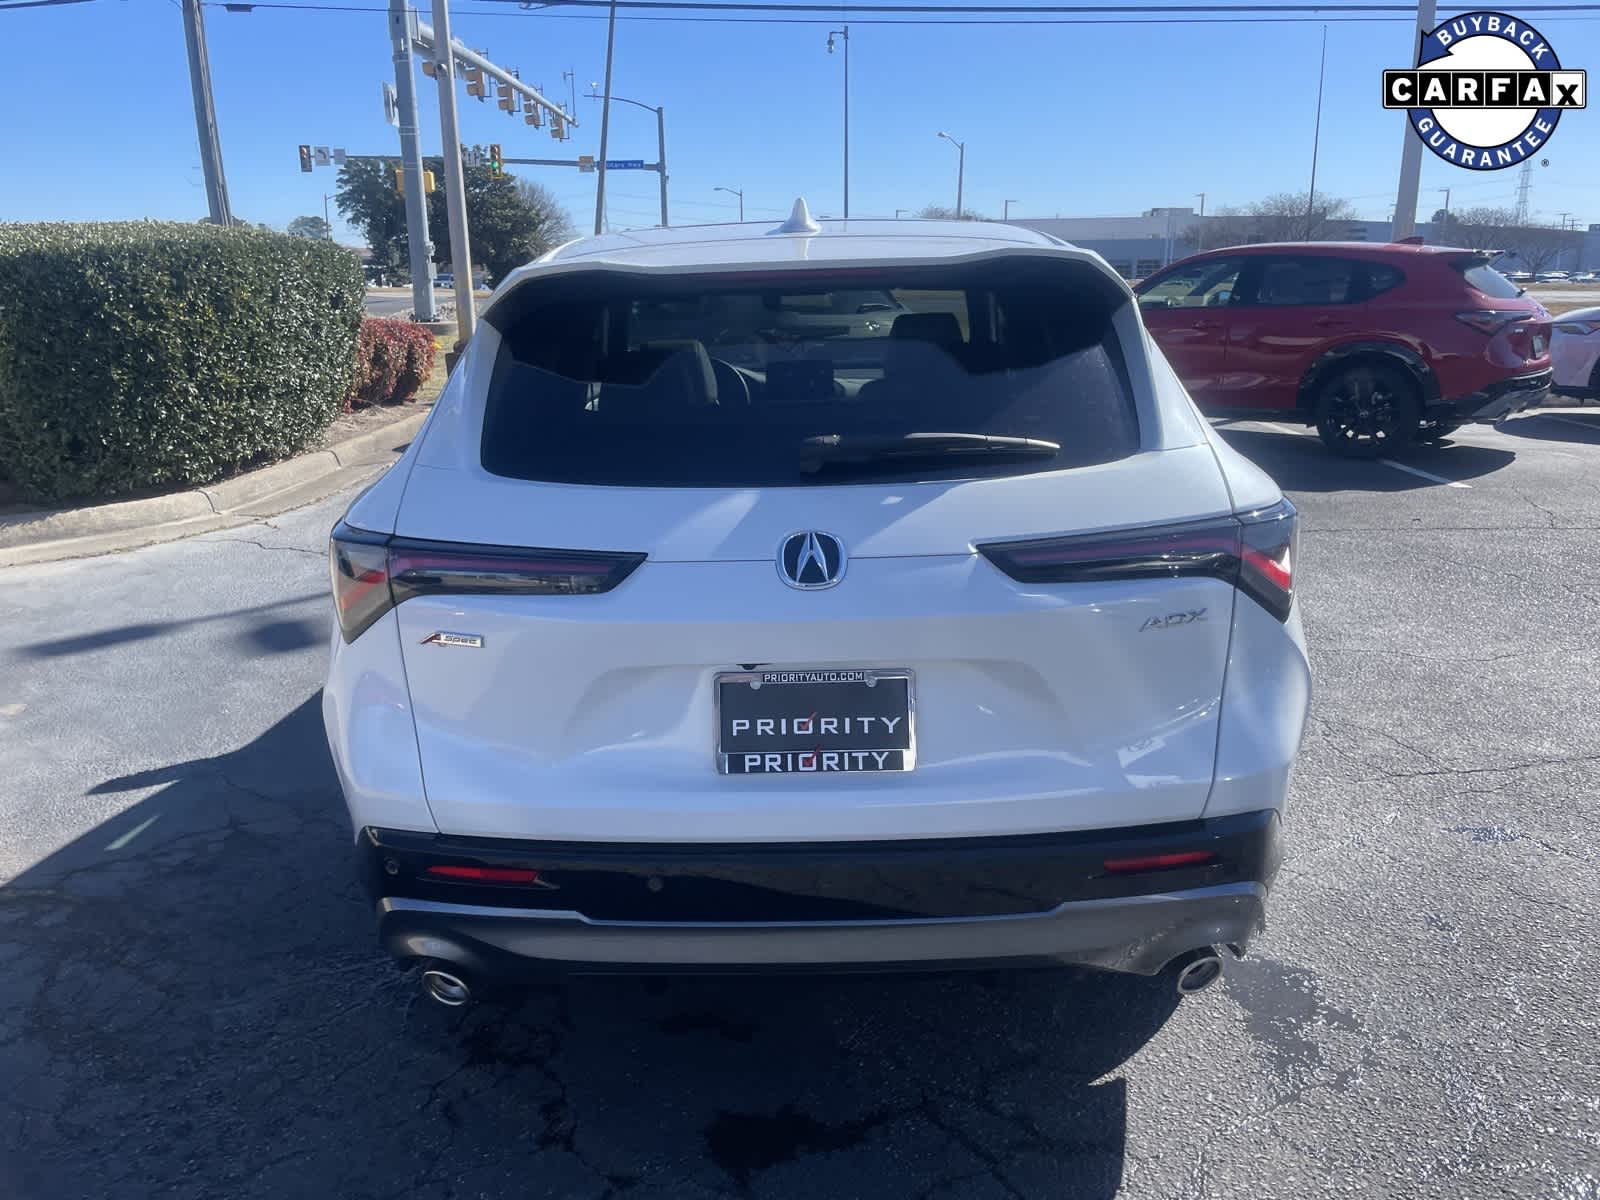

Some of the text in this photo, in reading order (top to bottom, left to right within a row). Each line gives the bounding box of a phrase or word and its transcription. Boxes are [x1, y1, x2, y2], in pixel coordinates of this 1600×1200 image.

[1138, 607, 1208, 633] ADX
[763, 672, 864, 683] PRIORITYAUTO.COM
[732, 716, 901, 737] PRIORITY
[744, 752, 889, 773] PRIORITY
